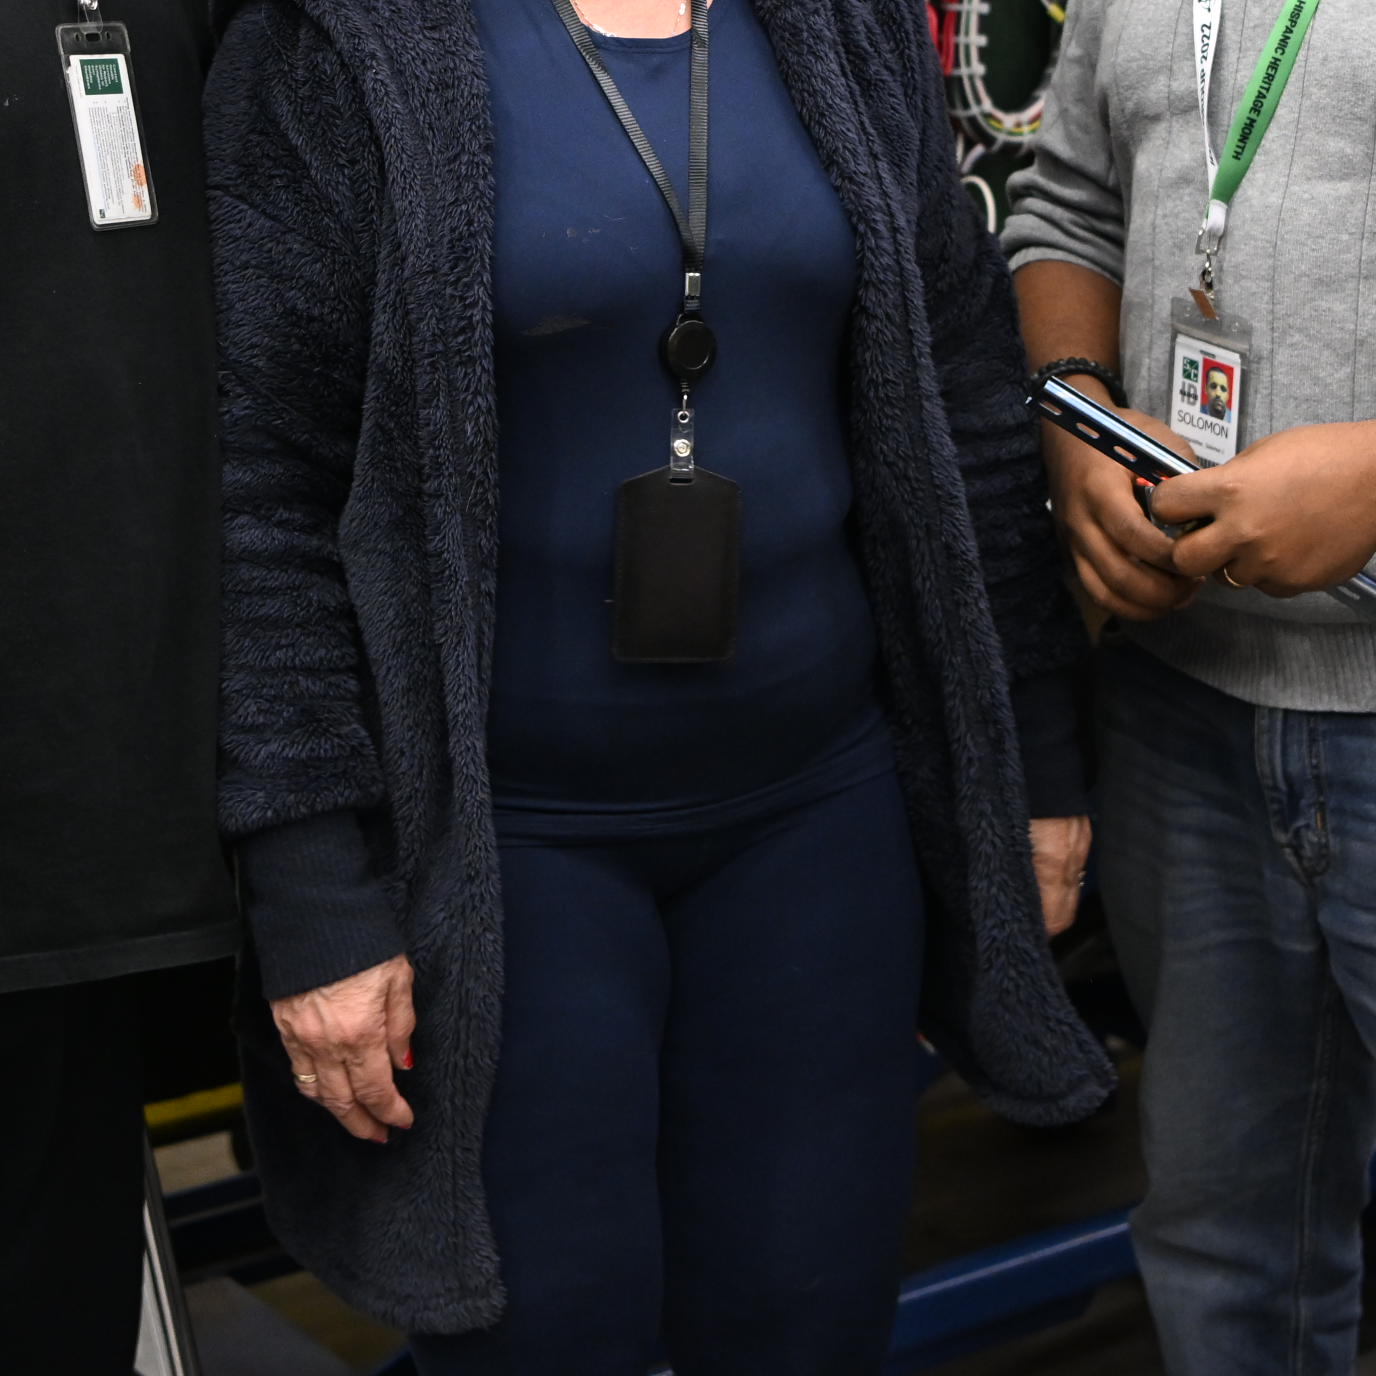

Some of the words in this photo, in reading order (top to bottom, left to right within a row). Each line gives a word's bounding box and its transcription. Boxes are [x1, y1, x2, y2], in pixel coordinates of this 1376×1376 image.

[1200, 22, 1212, 64] 2022
[1274, 0, 1306, 56] HISPANIC
[1249, 56, 1282, 116] HERITAGE
[1232, 112, 1257, 160] MONTH
[1177, 409, 1229, 439] SOLOMON
